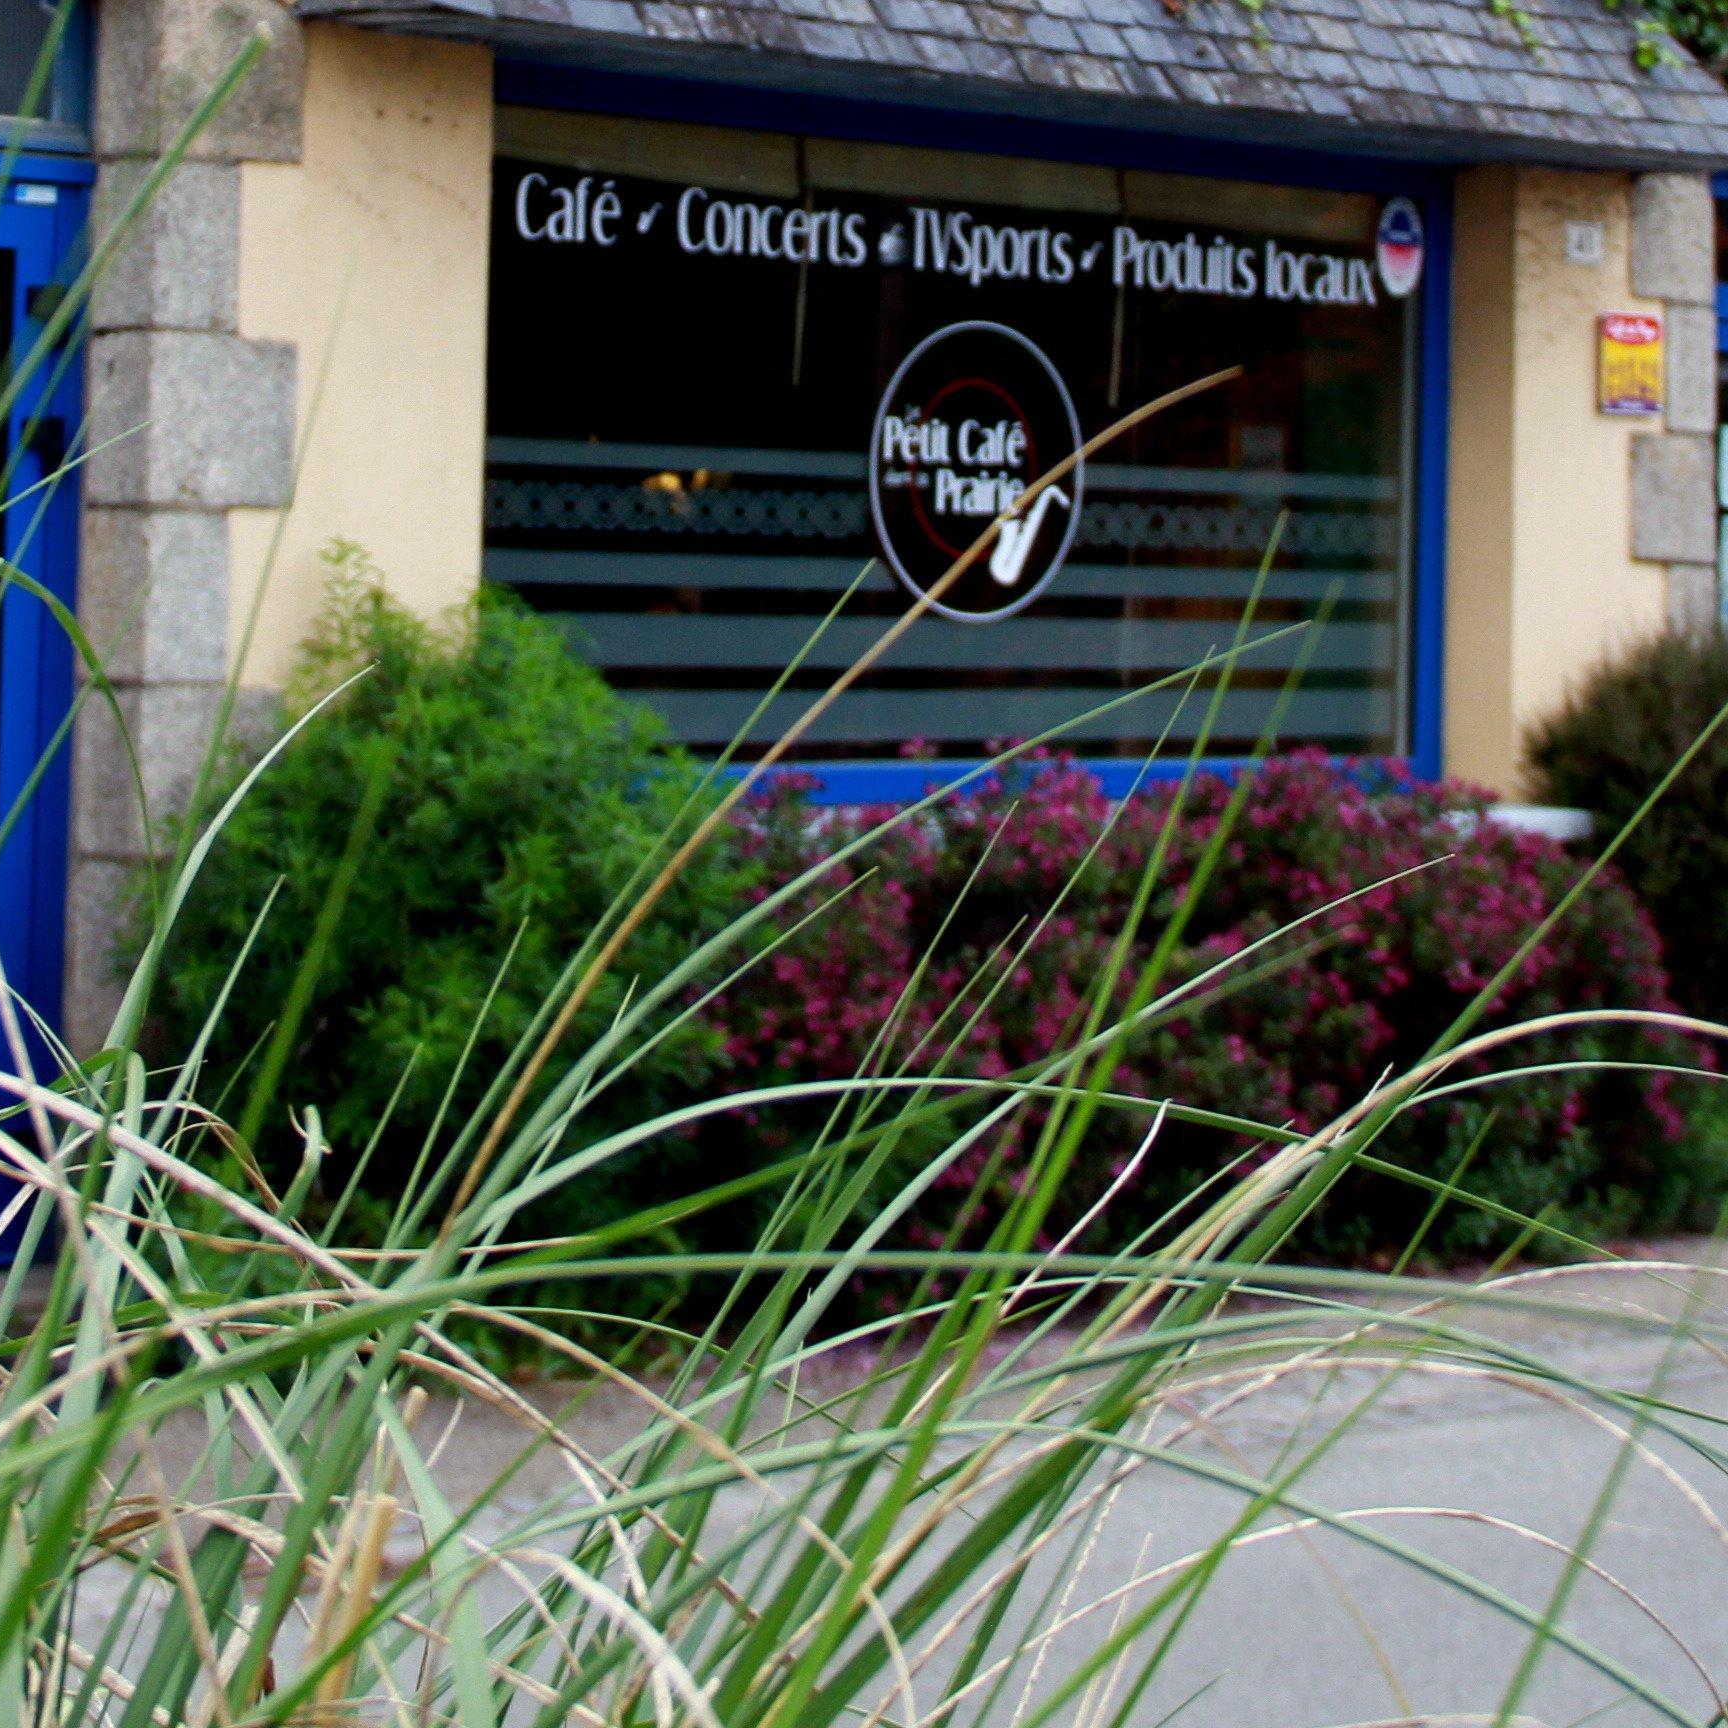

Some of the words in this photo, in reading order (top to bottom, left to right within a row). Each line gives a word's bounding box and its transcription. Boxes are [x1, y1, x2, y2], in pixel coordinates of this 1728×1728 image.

[514, 172, 622, 247] Café
[676, 186, 868, 268] Concerts
[1112, 224, 1257, 298] Produits
[1265, 239, 1377, 306] locaux
[883, 415, 950, 464] Petit
[958, 418, 1028, 468] Café
